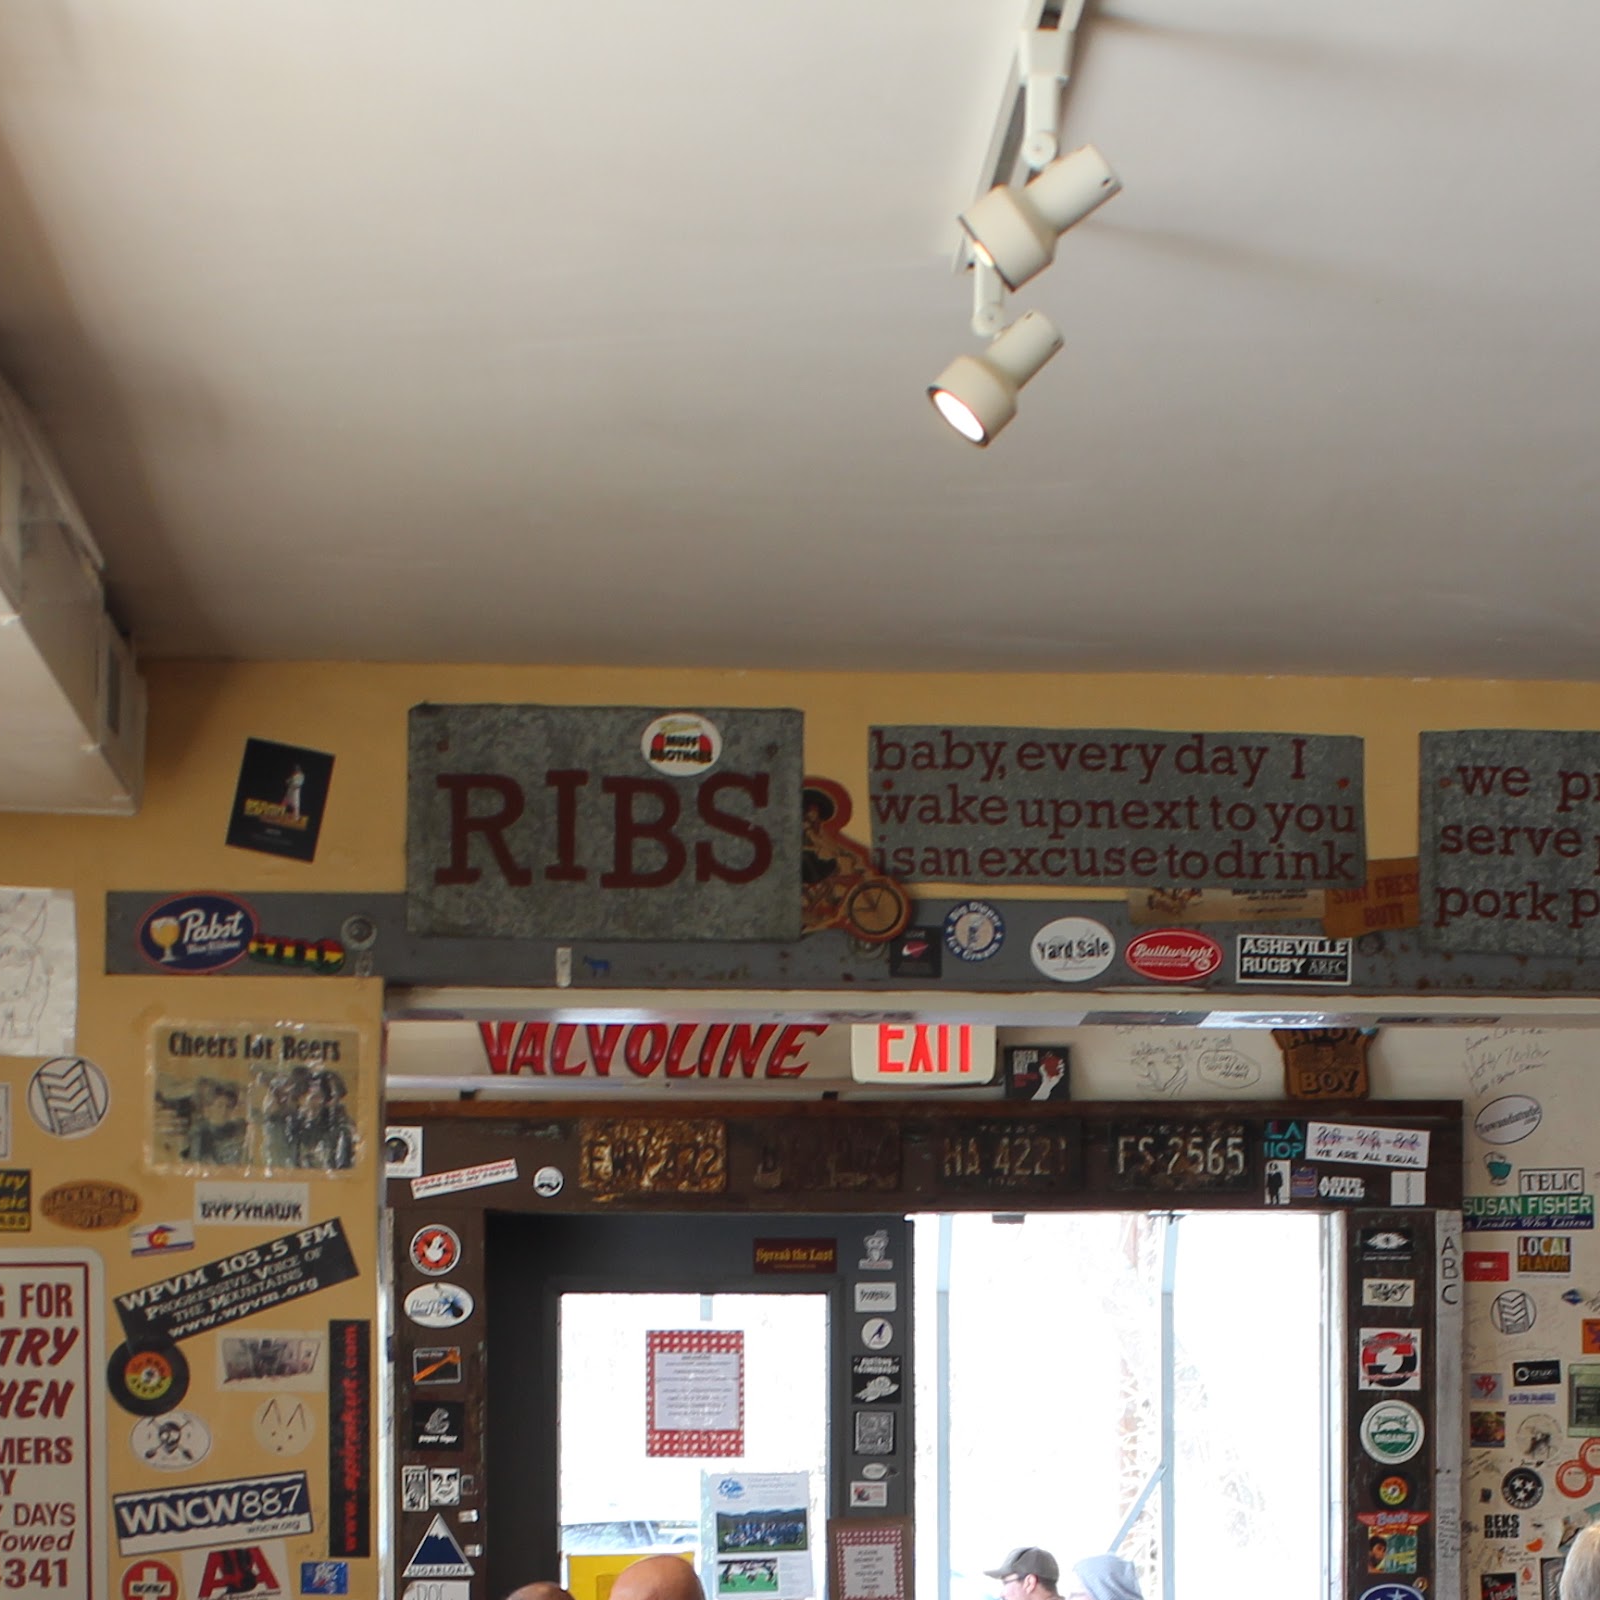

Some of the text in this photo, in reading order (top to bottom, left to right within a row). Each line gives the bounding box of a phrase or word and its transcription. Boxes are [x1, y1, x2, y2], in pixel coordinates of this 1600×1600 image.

[1017, 737, 1166, 783] every
[1174, 733, 1270, 789] day
[1290, 738, 1307, 780] I
[1456, 764, 1531, 797] we
[435, 770, 772, 887] RIBS
[870, 783, 1009, 825] wake
[1210, 793, 1257, 832] to
[1261, 801, 1357, 843] you
[1439, 823, 1583, 858] serve
[978, 844, 1167, 879] excuse
[1213, 839, 1357, 881] drink
[1434, 880, 1558, 927] pork
[178, 907, 245, 944] Pabst
[1037, 937, 1110, 961] Yard Sale
[1241, 938, 1348, 957] ASHEVILLE
[1241, 957, 1306, 974] RUGBY
[167, 1031, 342, 1062] Cheers for Beers
[478, 1022, 830, 1079] VALVOLINE
[877, 1023, 973, 1074] EXIT
[1301, 1071, 1360, 1094] BOY
[1315, 1148, 1420, 1166] WE ARE ALL EQUAL
[1522, 1172, 1580, 1192] TELIC
[1462, 1196, 1593, 1215] SUSAN FISHER
[1520, 1217, 1548, 1228] Who
[1549, 1218, 1593, 1228] Listens
[1440, 1235, 1458, 1257] A
[1518, 1237, 1570, 1256] LOCAL
[118, 1220, 339, 1313] WPVM 103.5 FM
[1442, 1258, 1459, 1280] B
[1517, 1256, 1570, 1272] FLAVOR
[143, 1246, 325, 1322] PROGRESSIVE VOICE OF
[172, 1267, 304, 1324] THE MOUNTAINS
[1440, 1284, 1459, 1306] C
[19, 1282, 74, 1319] FOR
[168, 1275, 320, 1339] www.wpvm.org
[13, 1503, 77, 1528] DAYS
[118, 1483, 303, 1534] WNCW 88.7
[246, 1519, 301, 1535] wncw.org
